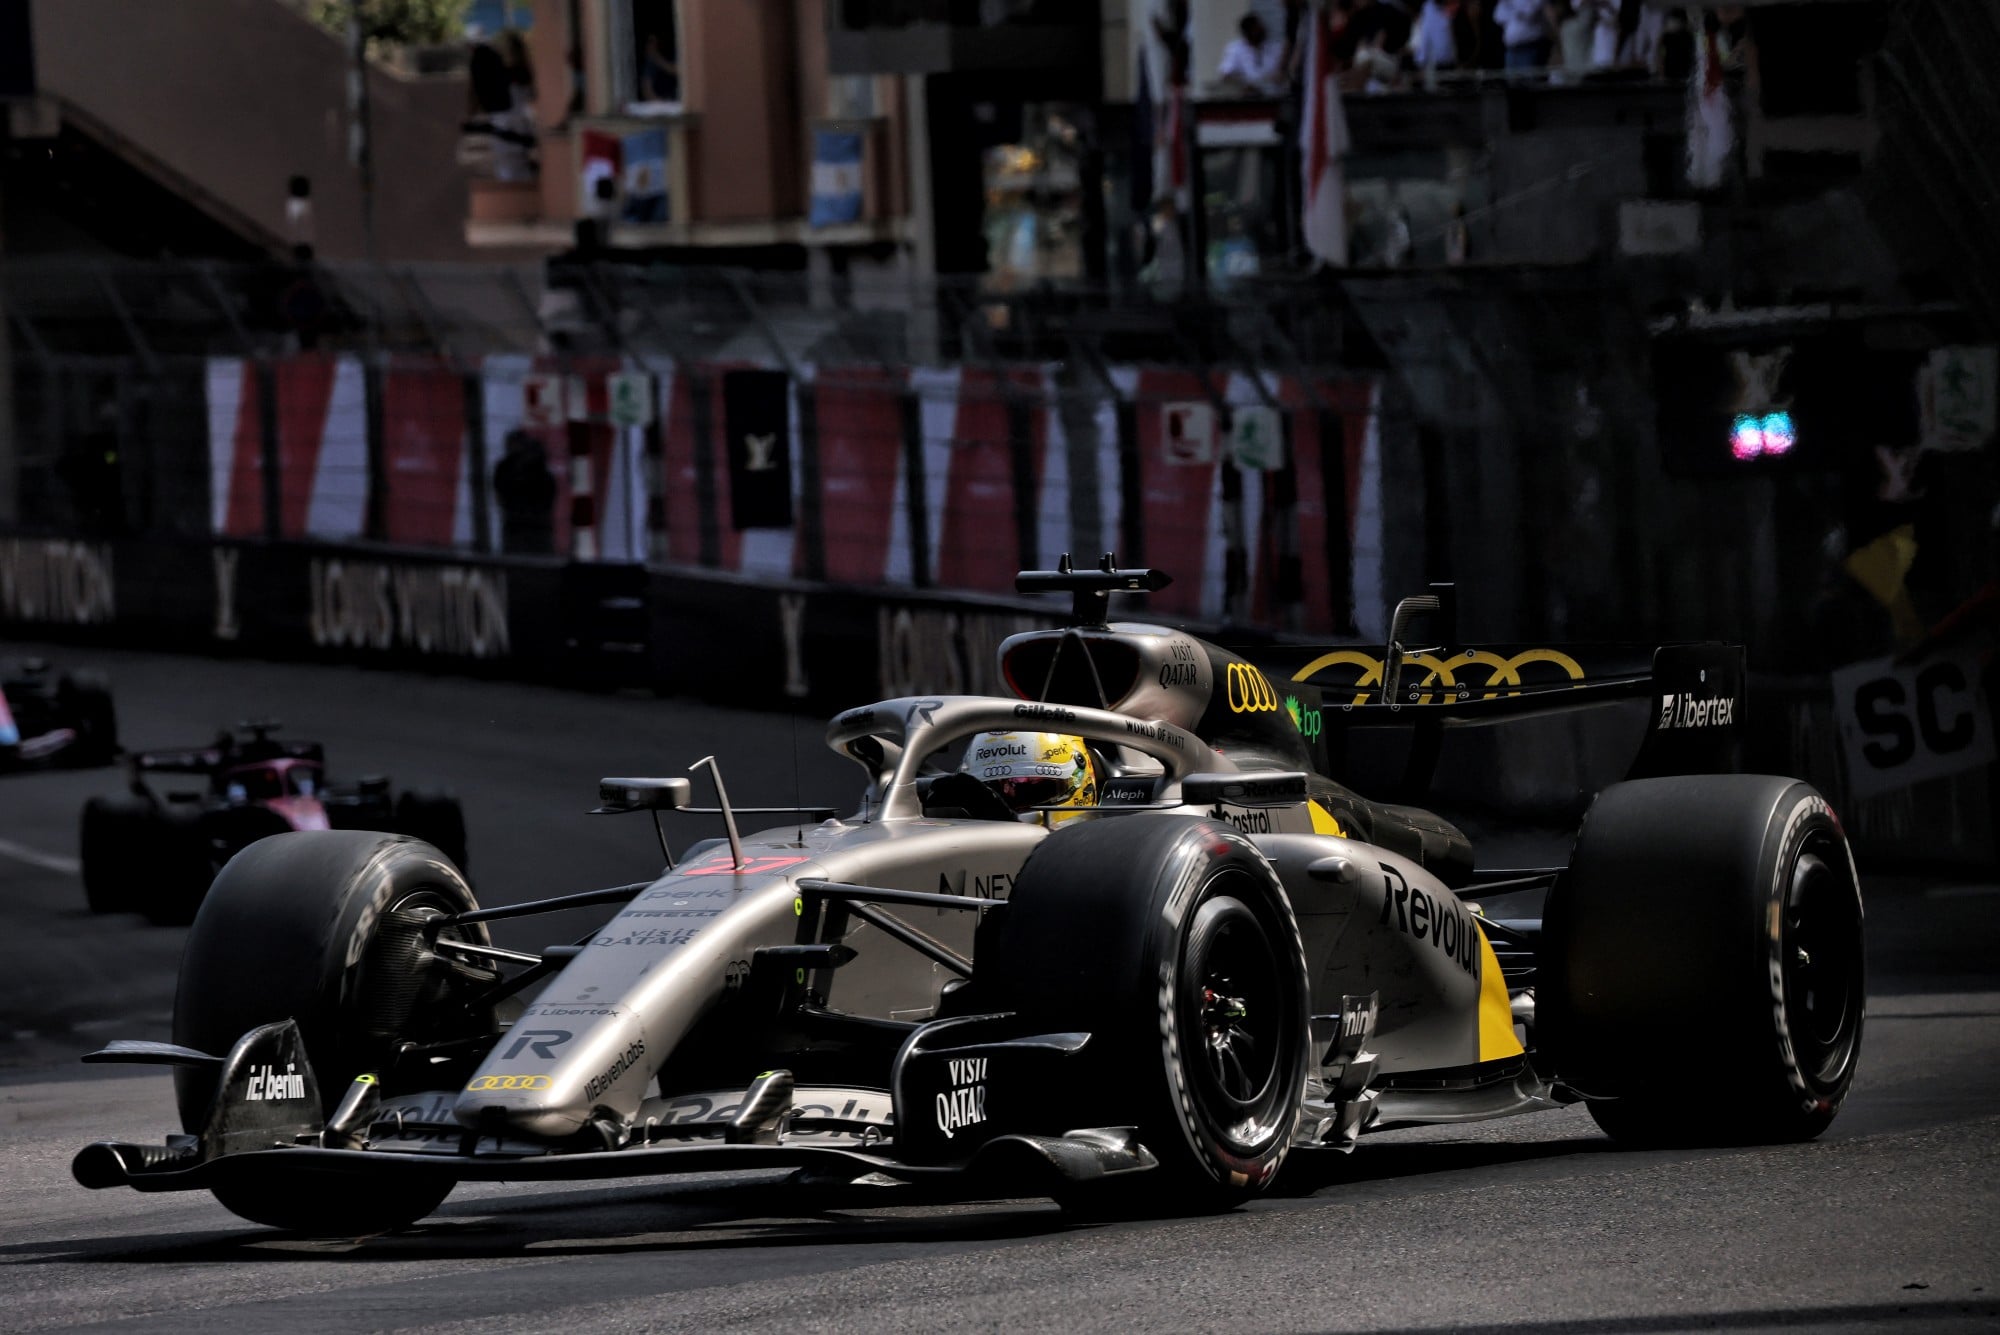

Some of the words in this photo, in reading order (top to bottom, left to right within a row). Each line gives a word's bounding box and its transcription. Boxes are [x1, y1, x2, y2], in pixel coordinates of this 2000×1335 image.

[1159, 663, 1197, 689] QATAR
[1014, 703, 1076, 722] Gillette
[1673, 692, 1734, 728] Libertex
[1855, 662, 1974, 769] SC
[1125, 719, 1156, 739] WORLD
[1156, 727, 1167, 742] OF
[1303, 703, 1321, 744] bp
[975, 743, 1028, 761] Revolut
[1106, 788, 1146, 801] Aleph
[683, 856, 809, 876] 27
[1378, 861, 1478, 979] Revolut
[591, 936, 690, 948] QATAR
[540, 1008, 619, 1016] Libertex
[501, 1029, 573, 1060] R
[264, 1062, 306, 1100] berlin
[936, 1085, 987, 1139] QATAR
